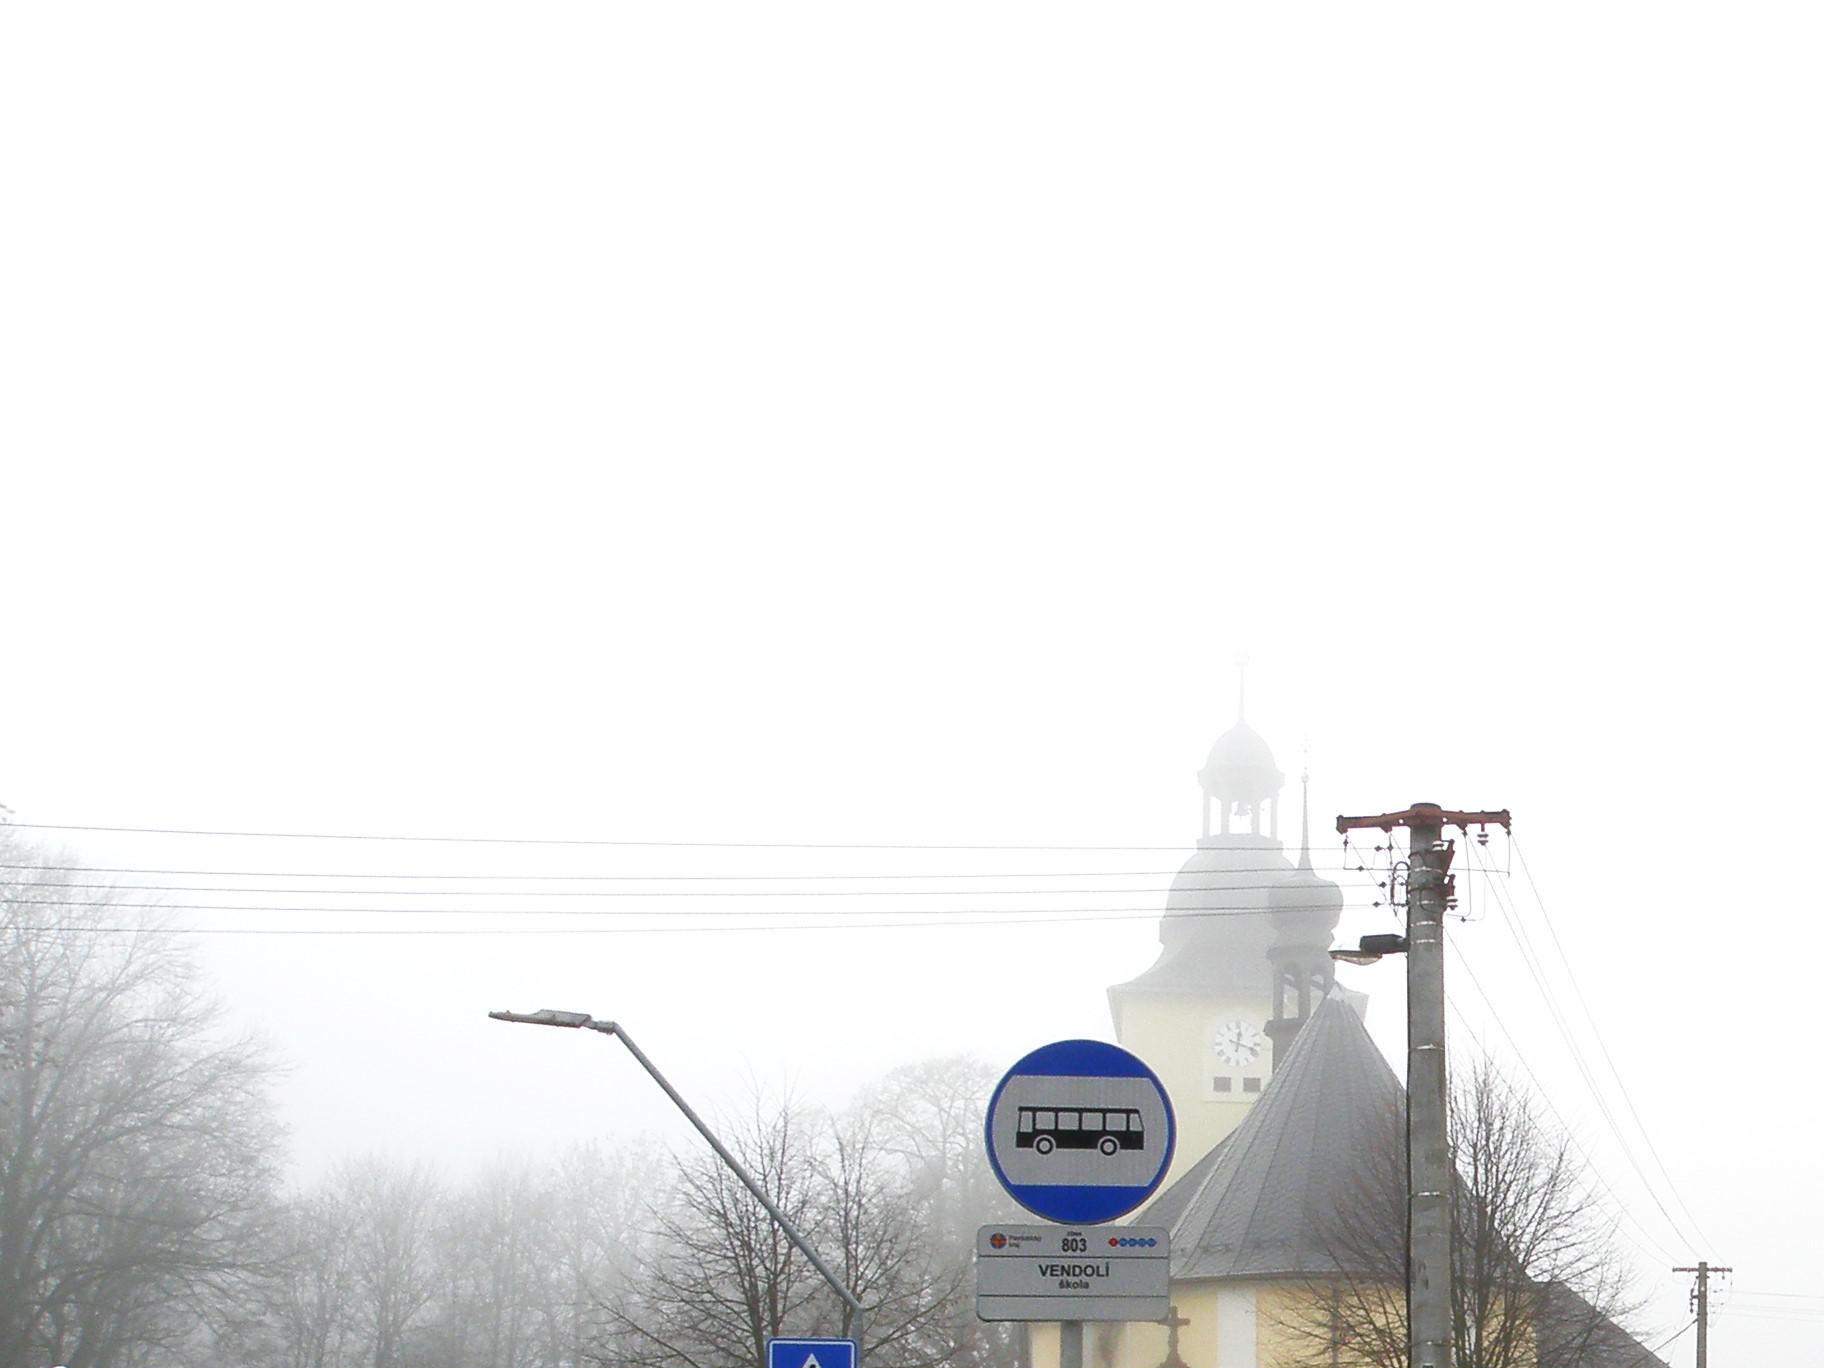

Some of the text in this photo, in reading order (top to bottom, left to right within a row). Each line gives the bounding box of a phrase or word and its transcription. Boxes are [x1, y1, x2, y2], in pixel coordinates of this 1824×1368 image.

[1061, 1237, 1088, 1253] 803
[1038, 1262, 1110, 1278] VENDOLÍ
[1058, 1279, 1090, 1290] škola
